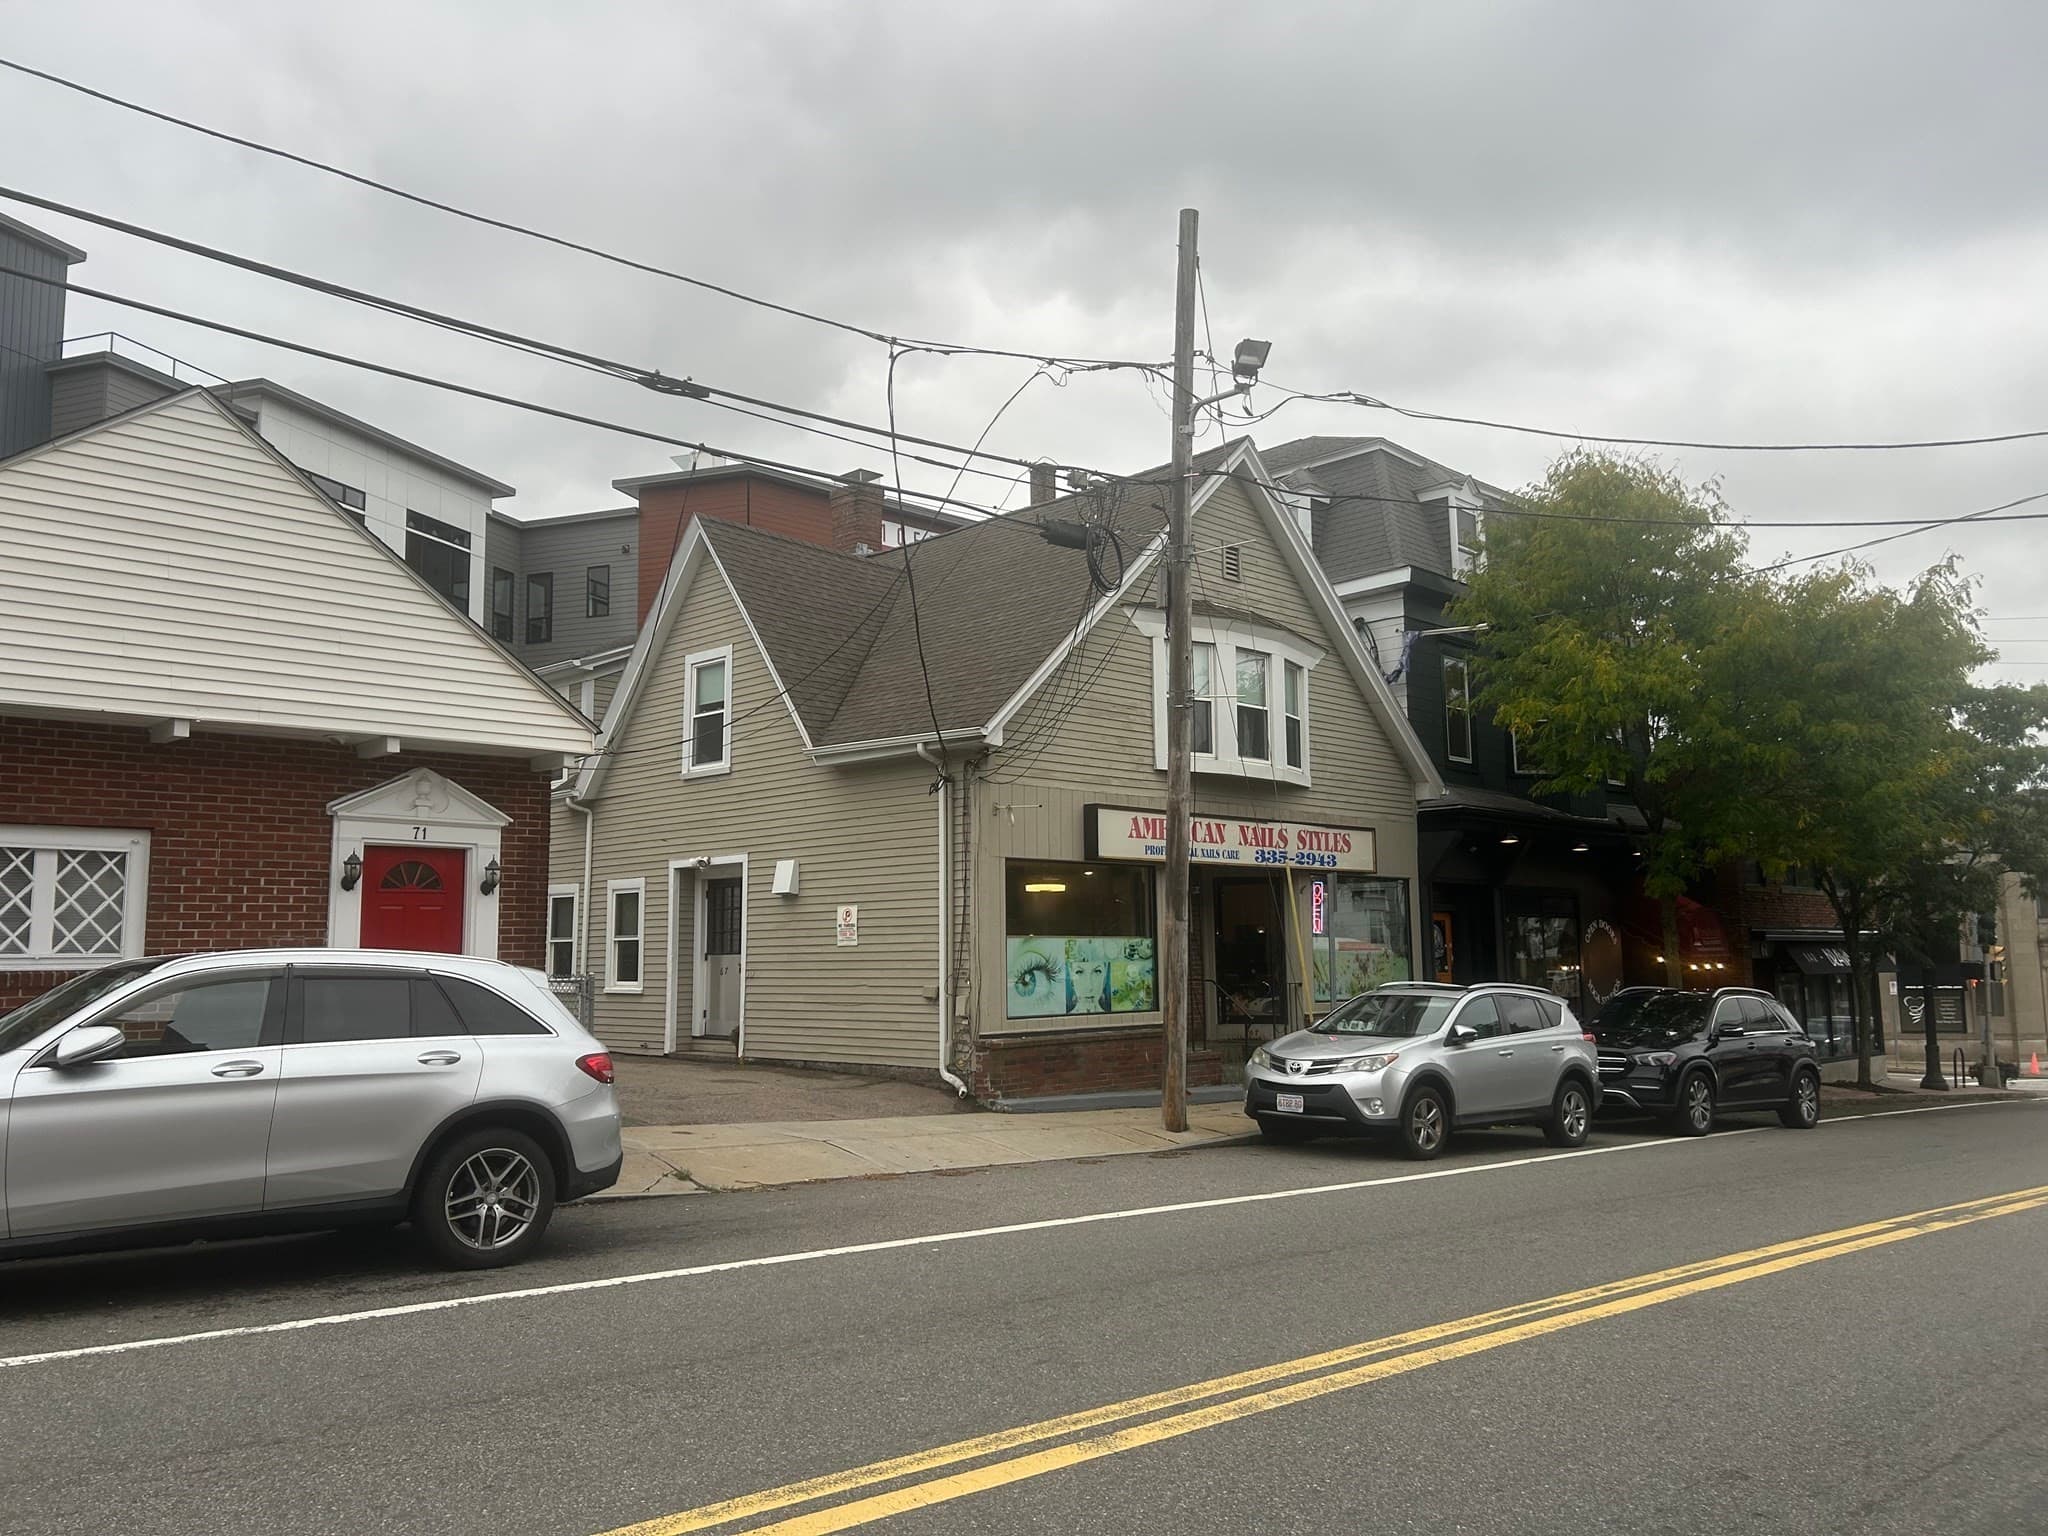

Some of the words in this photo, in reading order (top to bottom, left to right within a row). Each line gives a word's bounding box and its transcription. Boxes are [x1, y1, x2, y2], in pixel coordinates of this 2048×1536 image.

[412, 826, 427, 840] 71
[1238, 824, 1289, 850] NAILS
[1296, 828, 1352, 854] STYLES
[1201, 848, 1220, 859] NAILS
[1222, 849, 1240, 860] CARE
[1254, 848, 1338, 868] 335-2943
[1313, 884, 1322, 933] OPEN
